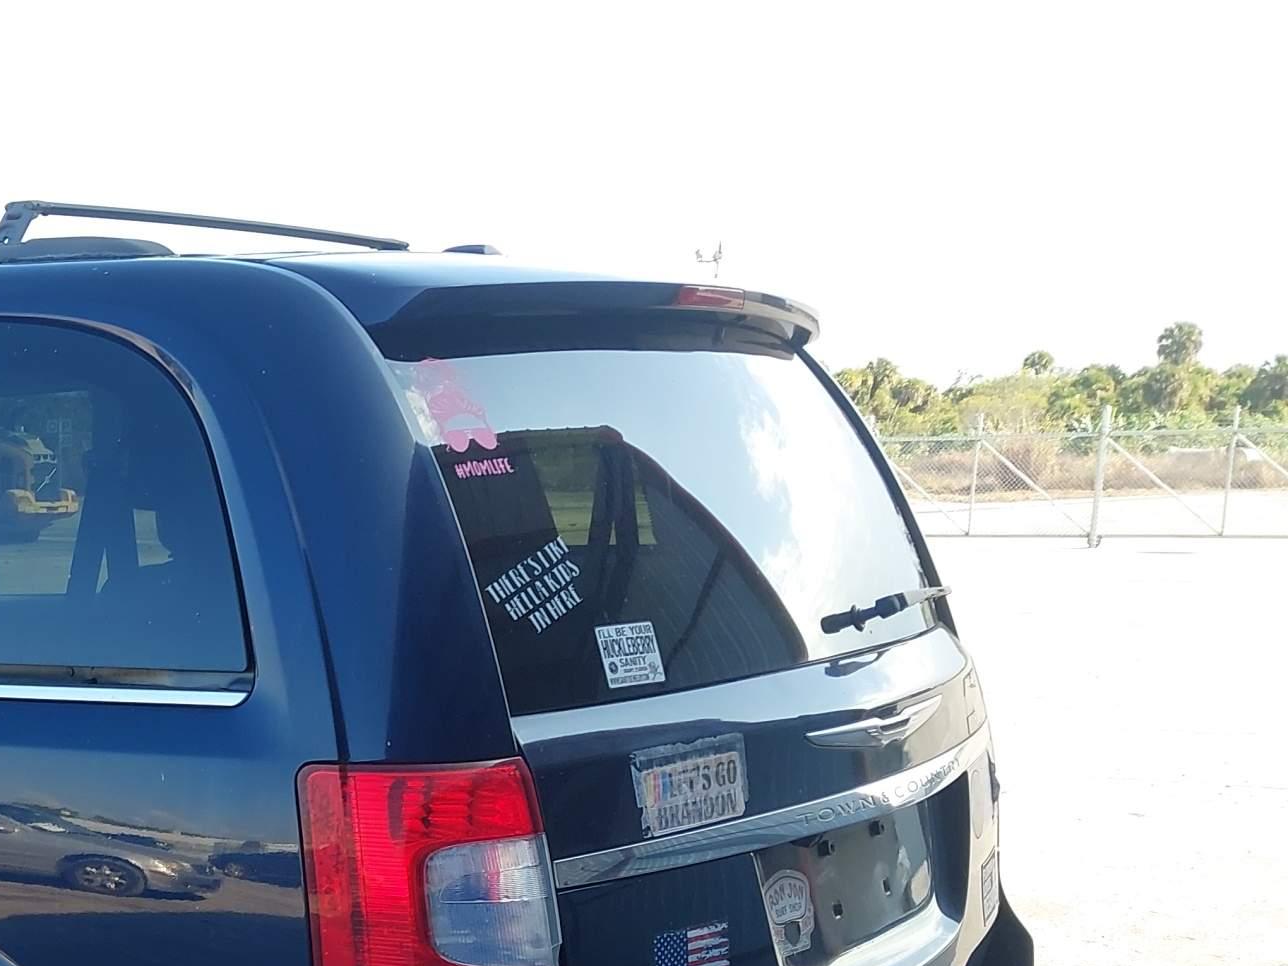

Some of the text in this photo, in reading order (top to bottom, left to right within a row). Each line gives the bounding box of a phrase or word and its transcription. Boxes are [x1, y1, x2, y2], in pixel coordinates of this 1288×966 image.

[454, 457, 515, 479] #MOMLIFE
[485, 556, 543, 604] THERE'S
[504, 559, 581, 621] HELLA KIDS
[528, 583, 584, 634] IN HERE
[600, 634, 657, 659] HUCKLEBERRY
[615, 626, 627, 637] BE
[628, 623, 653, 636] YOUR
[618, 655, 648, 668] SANITY
[715, 759, 738, 787] GO
[796, 757, 961, 825] TOWN & COUNTRY
[657, 787, 739, 831] BRANDON
